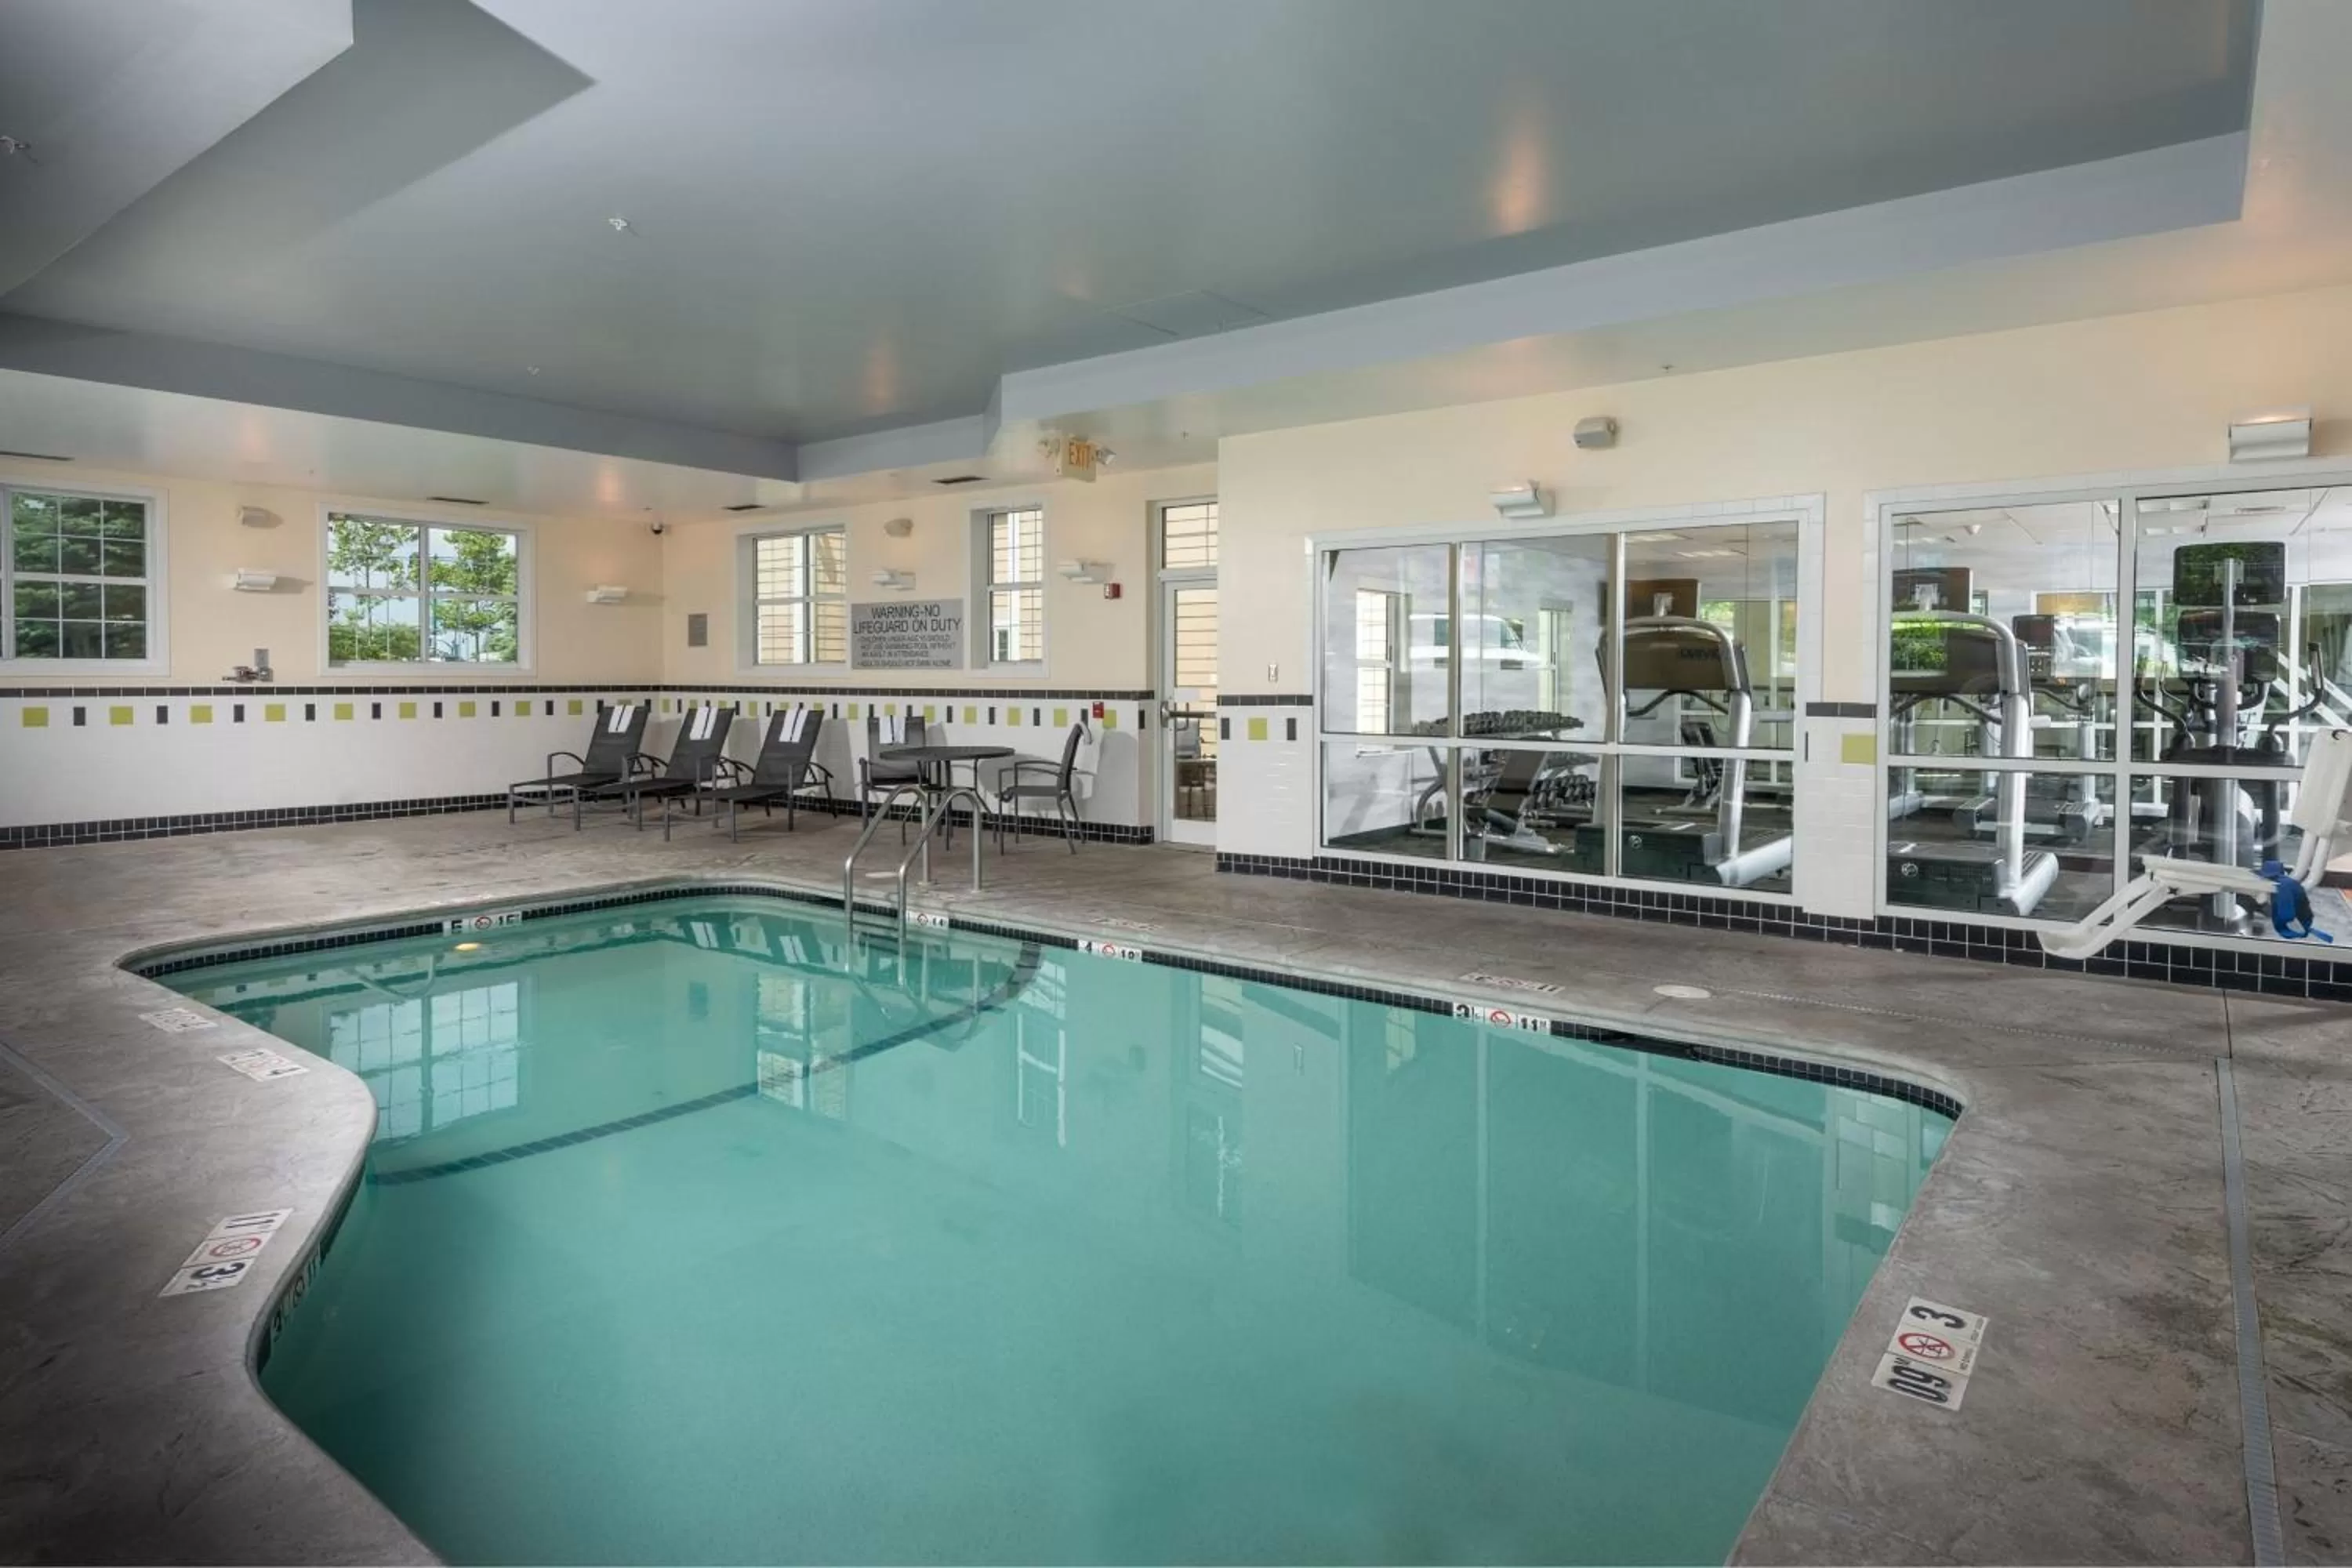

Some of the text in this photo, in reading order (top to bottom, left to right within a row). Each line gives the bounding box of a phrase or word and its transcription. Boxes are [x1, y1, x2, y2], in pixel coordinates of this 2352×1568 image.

[1069, 441, 1090, 470] EXIT
[853, 618, 961, 634] LIFEGUARD ON DUTY
[1910, 1305, 1967, 1329] 3
